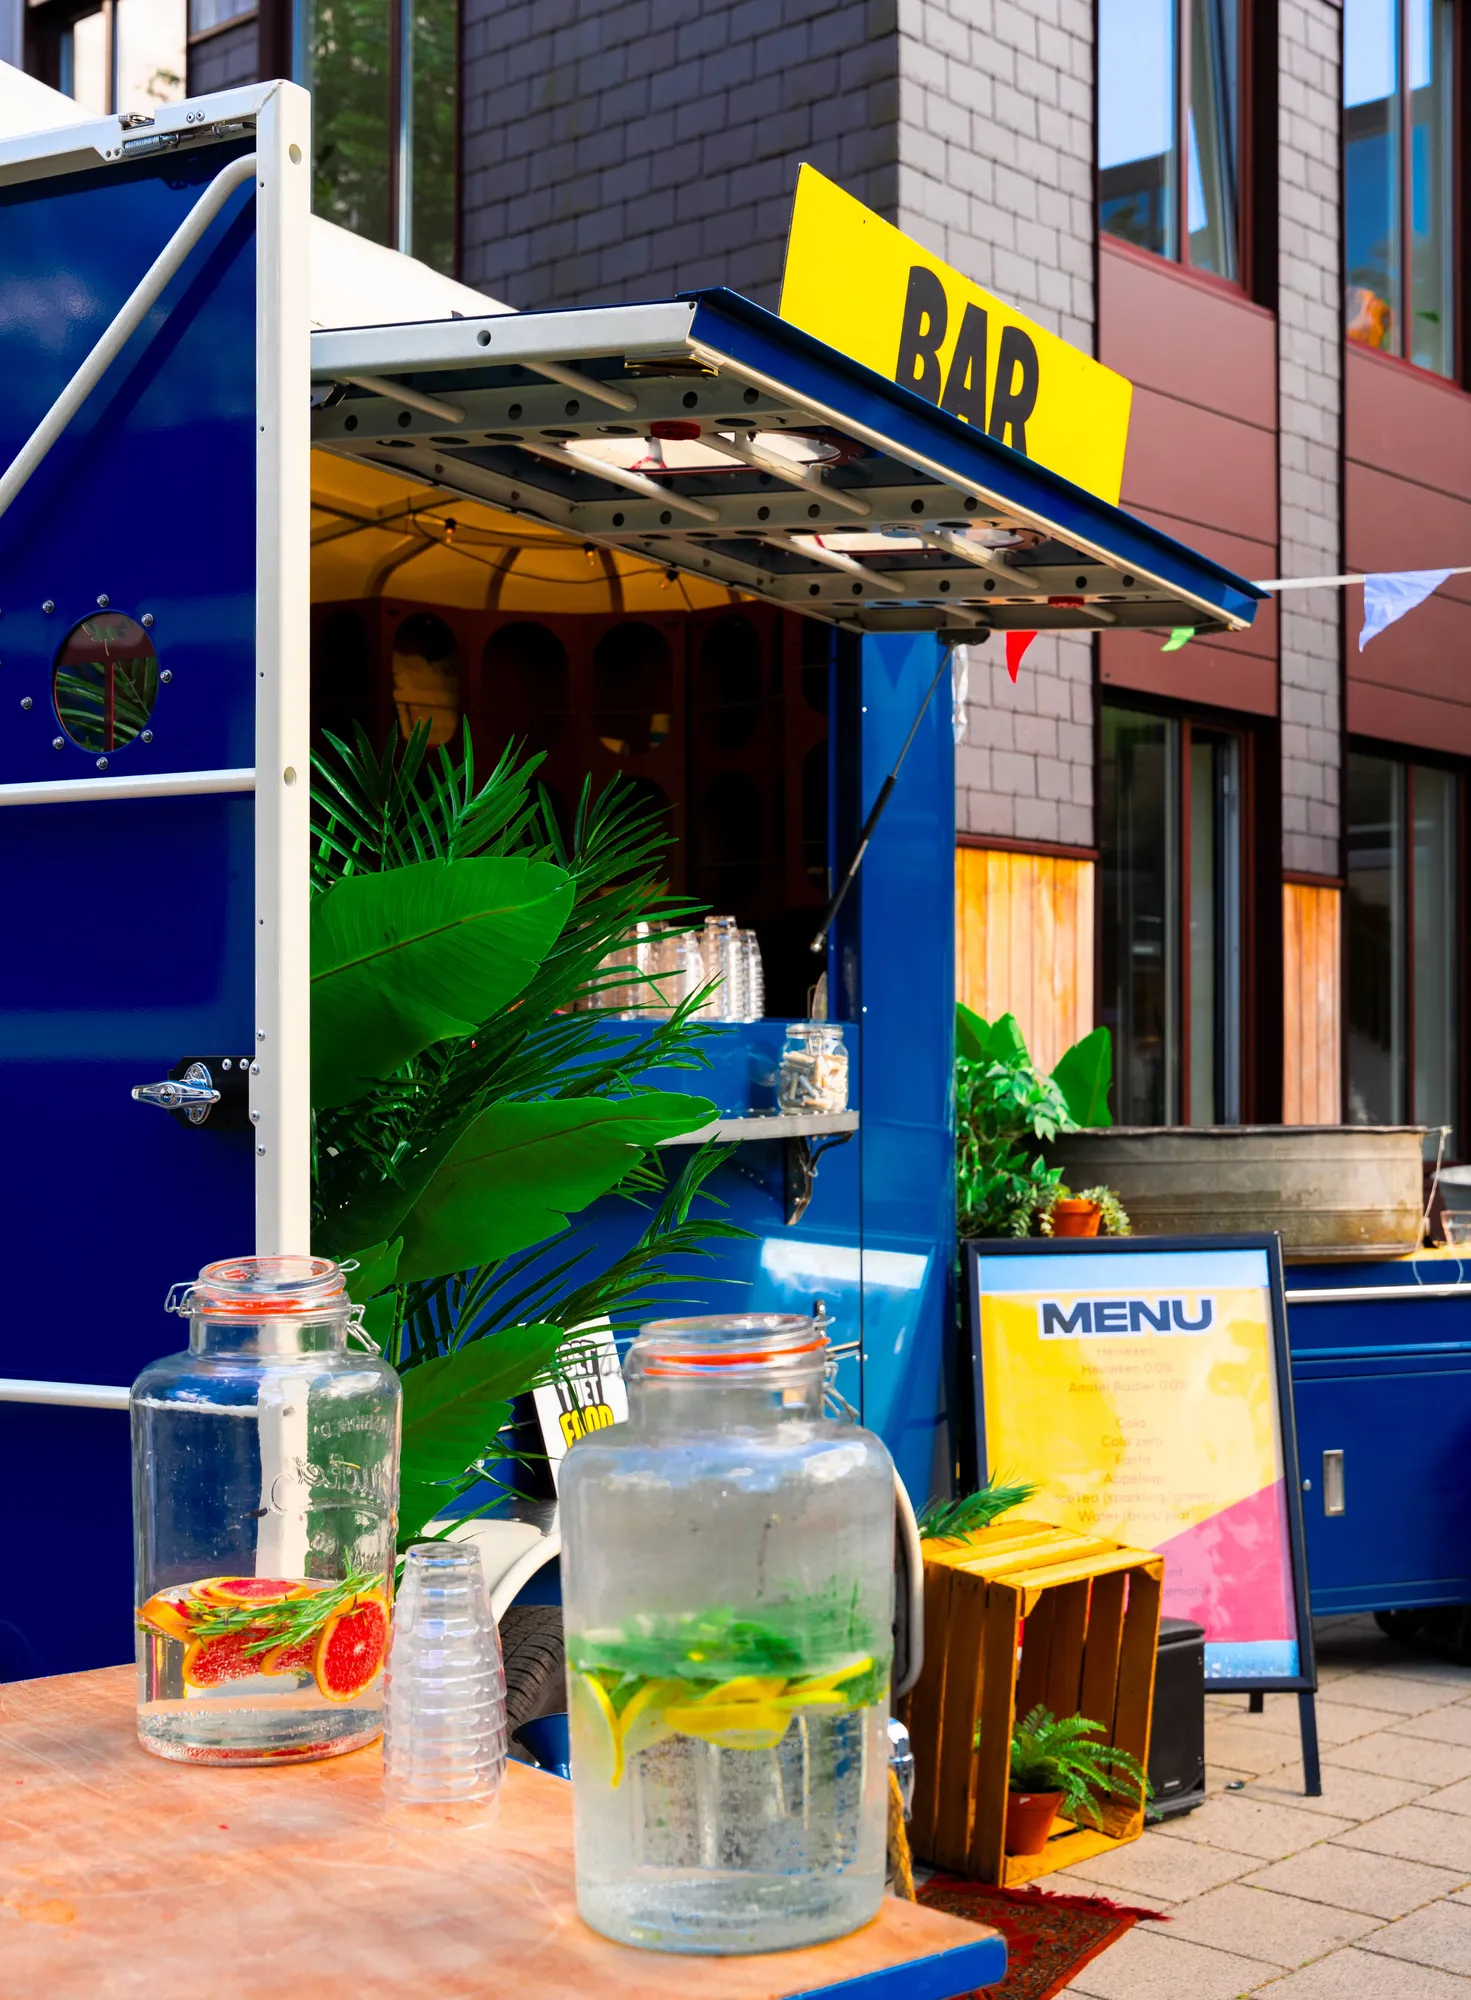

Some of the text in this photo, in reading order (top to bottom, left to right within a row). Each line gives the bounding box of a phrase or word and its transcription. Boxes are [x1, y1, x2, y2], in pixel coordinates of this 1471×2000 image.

[895, 266, 1039, 456] BAR
[1043, 1300, 1212, 1334] MENU
[559, 1404, 615, 1449] FOOD
[1116, 1417, 1146, 1428] Cola
[1100, 1435, 1132, 1448] Cola
[1115, 1454, 1151, 1465] Fanta
[1078, 1510, 1119, 1523] Water
